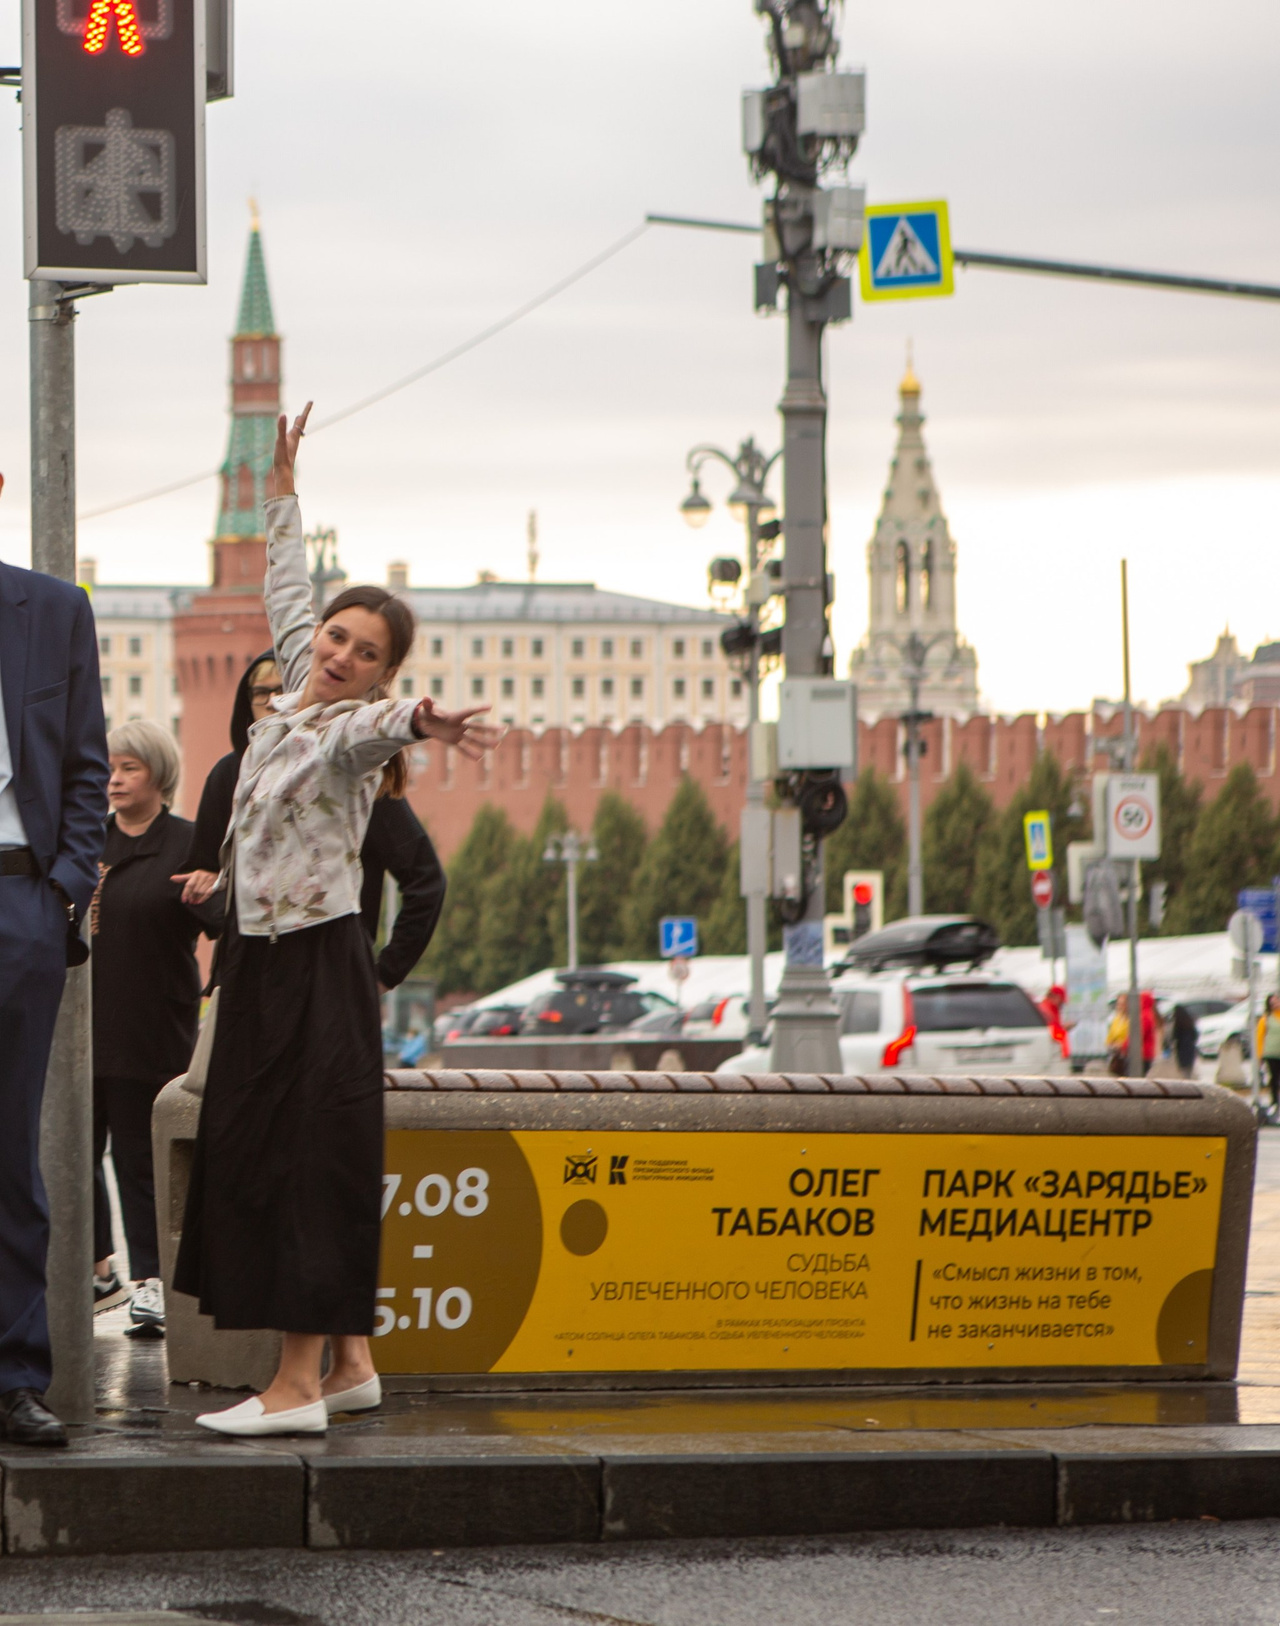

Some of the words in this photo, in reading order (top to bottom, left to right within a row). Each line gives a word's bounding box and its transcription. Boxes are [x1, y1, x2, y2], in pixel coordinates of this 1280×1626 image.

[789, 1168, 881, 1197] ОЛЕГ
[922, 1169, 1016, 1198] ПАРК
[1024, 1169, 1208, 1204] «ЗАРЯДЬЕ»
[711, 1207, 875, 1237] ТАБАКОВ
[919, 1208, 1153, 1242] МЕДИАЦЕНТР
[786, 1253, 871, 1276] СУДЬБА
[932, 1263, 1010, 1282] «Смысл
[1014, 1266, 1080, 1282] жизни
[1086, 1266, 1098, 1281] в
[1102, 1266, 1143, 1285] том,
[589, 1281, 750, 1301] УВЛЕЧЕННОГО
[755, 1280, 868, 1300] ЧЕЛОВЕКА
[929, 1294, 963, 1310] что
[967, 1294, 1032, 1310] жизнь
[1037, 1294, 1061, 1309] на
[1066, 1289, 1112, 1309] тебе
[927, 1323, 952, 1338] не
[957, 1322, 1115, 1338] заканчивается»
